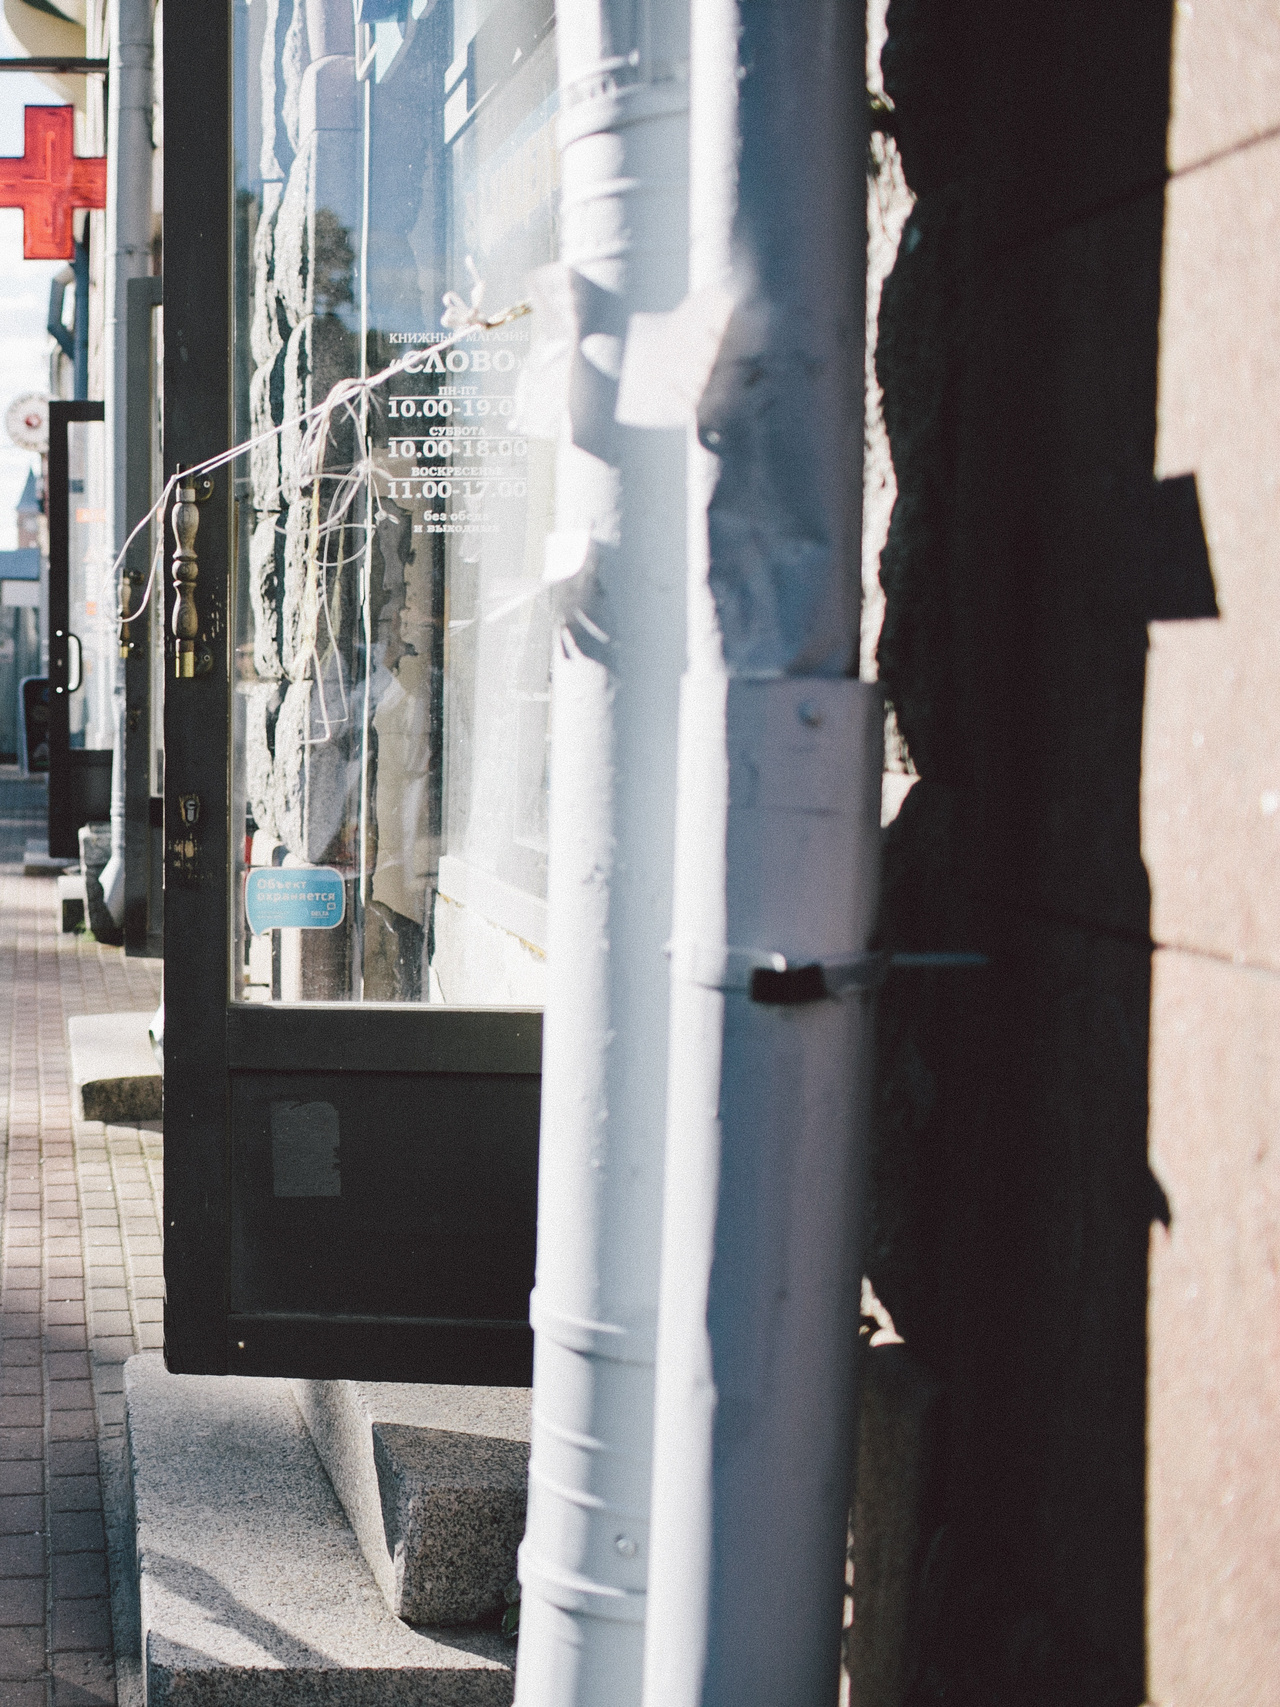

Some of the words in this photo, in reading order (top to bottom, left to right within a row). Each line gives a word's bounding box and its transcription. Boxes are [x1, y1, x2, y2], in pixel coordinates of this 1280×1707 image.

[466, 331, 529, 342] МАГАЗИН
[438, 386, 478, 395] ПН-ПТ
[429, 426, 486, 437] СУББОТА
[388, 440, 528, 458] 10.00-18.00
[387, 481, 527, 499] 11.00-17.00
[423, 510, 447, 521] без
[257, 878, 307, 890] Объект
[257, 892, 335, 902] охраняется
